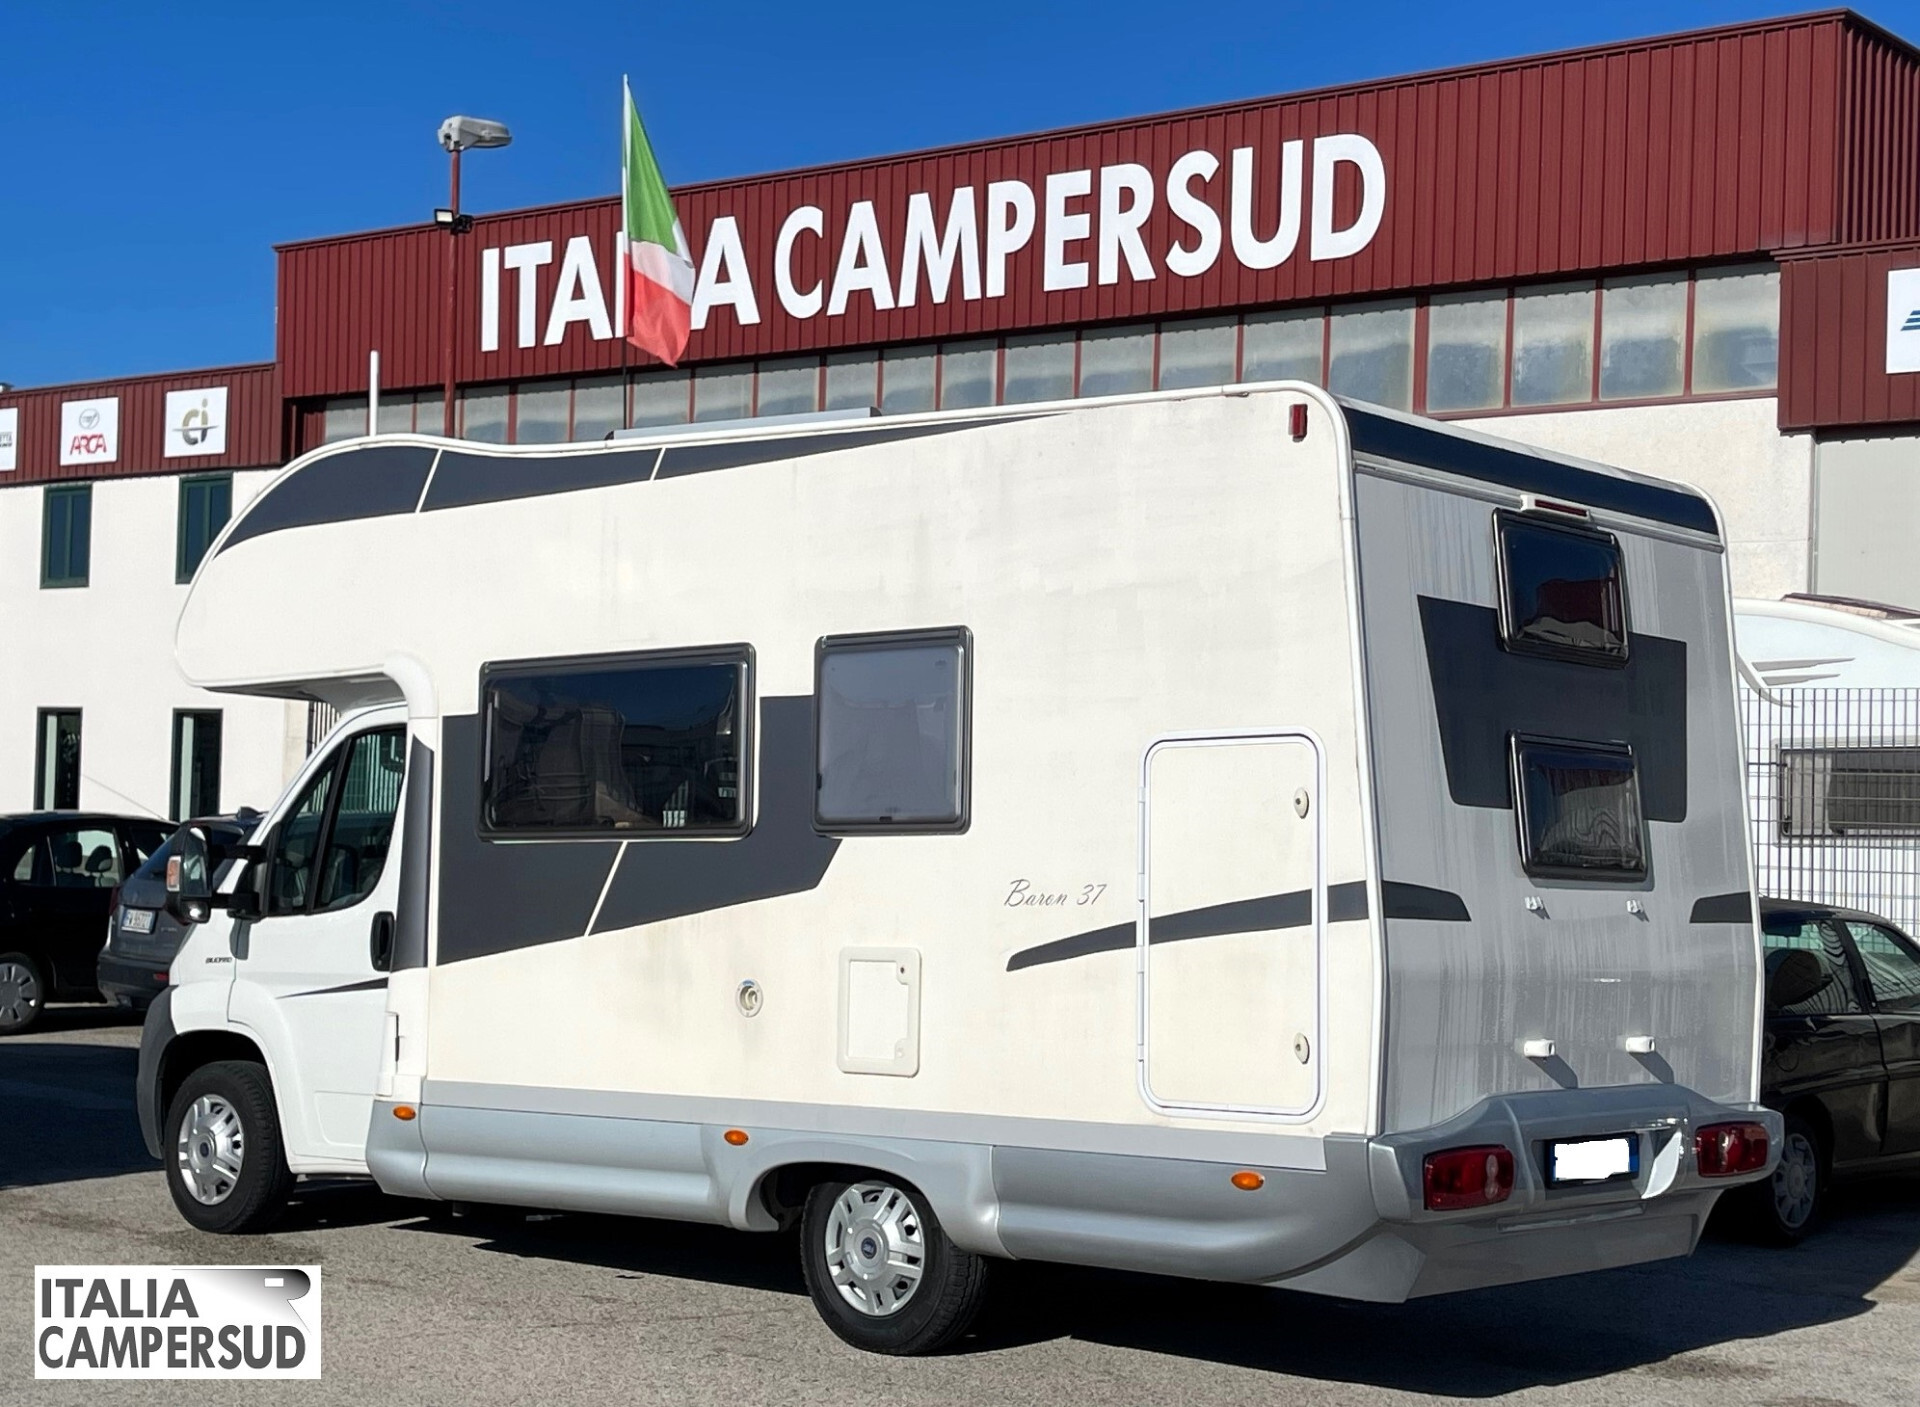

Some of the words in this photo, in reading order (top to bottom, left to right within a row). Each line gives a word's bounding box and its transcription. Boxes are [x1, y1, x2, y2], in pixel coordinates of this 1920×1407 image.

[478, 216, 761, 352] ITAA
[774, 133, 1387, 319] CAMPERSUD
[70, 433, 107, 455] ARCA
[1003, 879, 1068, 907] Baron
[1076, 883, 1108, 906] 37
